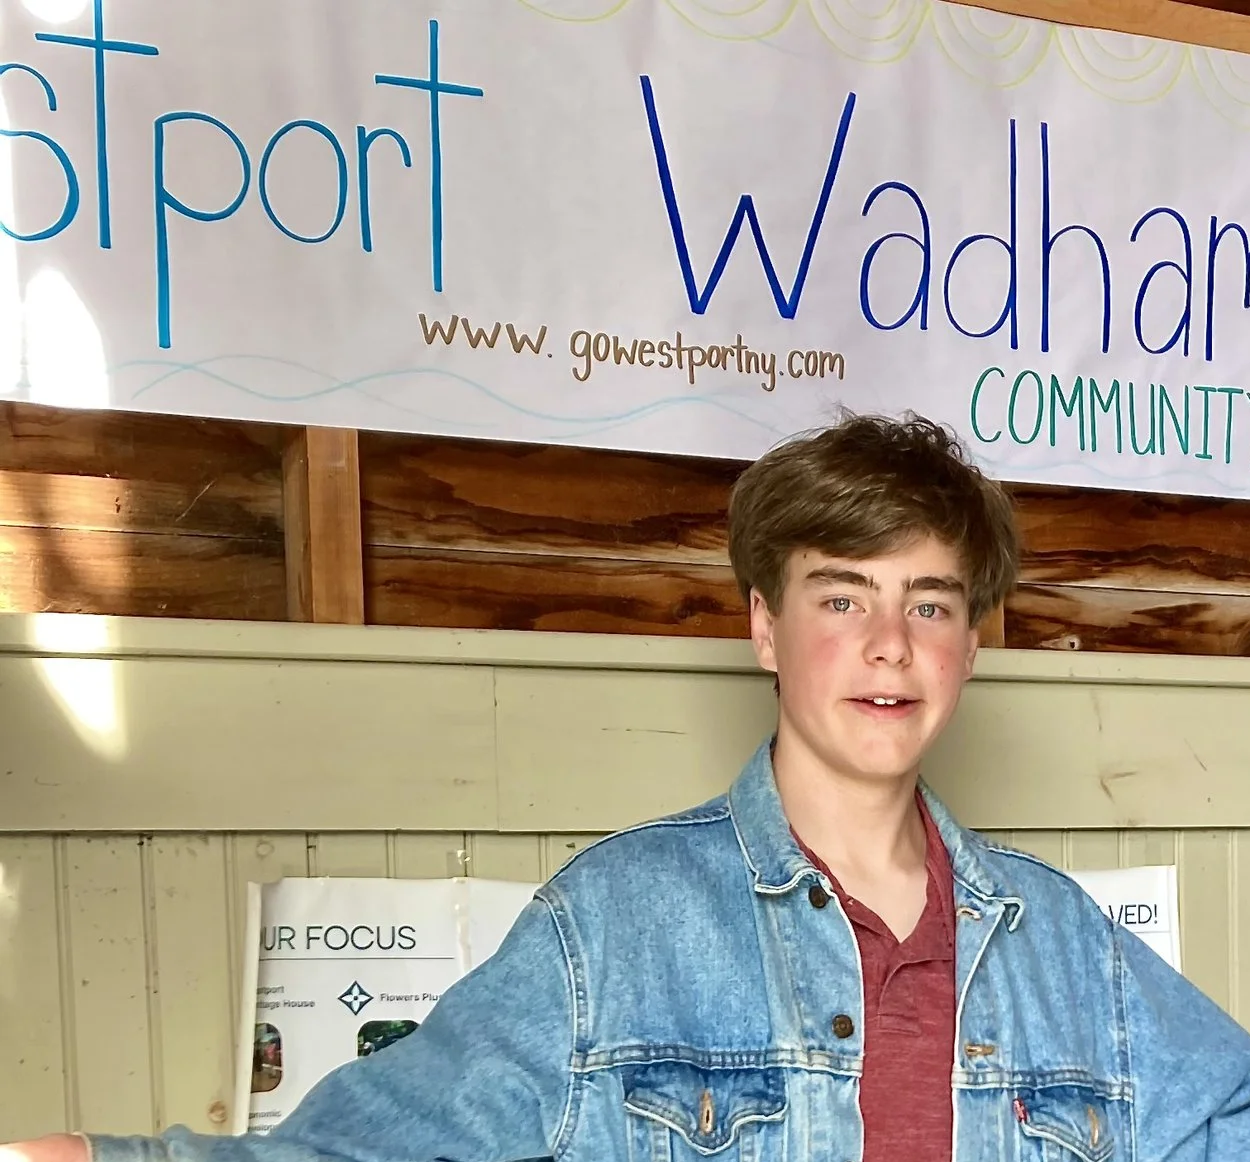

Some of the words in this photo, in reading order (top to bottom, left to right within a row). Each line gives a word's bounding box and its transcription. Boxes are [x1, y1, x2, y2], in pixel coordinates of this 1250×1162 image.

[418, 312, 553, 358] www.
[569, 330, 845, 391] gowestportny.com
[260, 925, 296, 951] UR
[306, 924, 417, 951] FOCUS
[380, 992, 420, 1002] Flowers
[422, 992, 441, 1002] Plu
